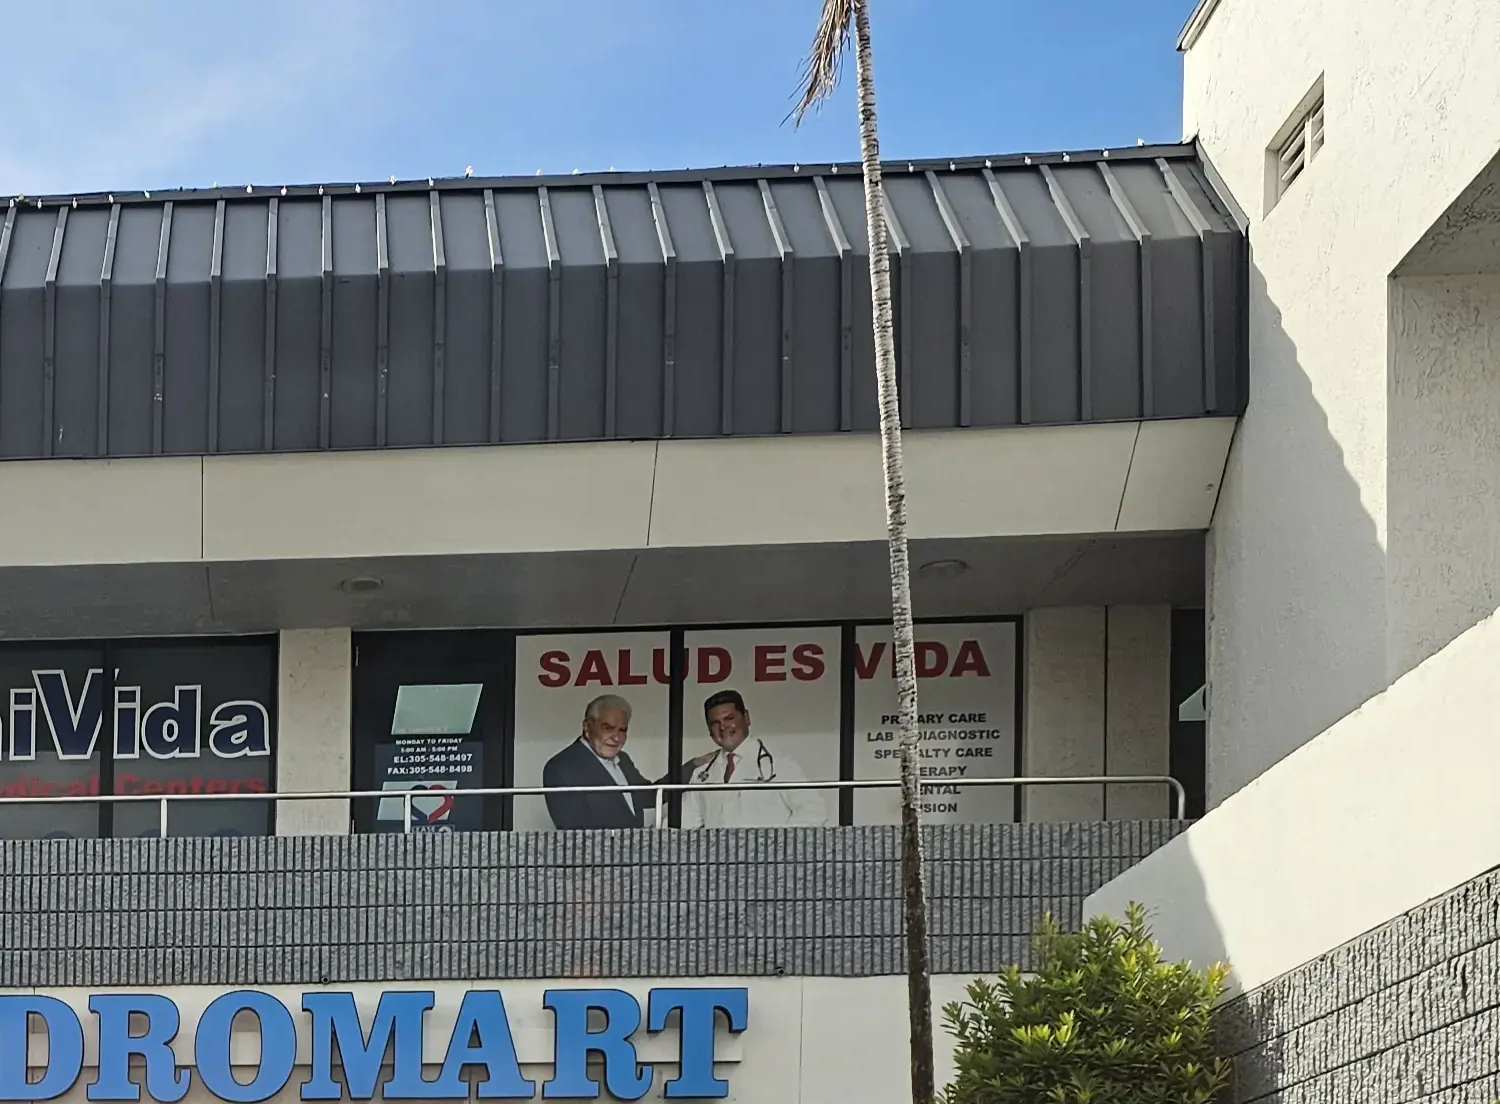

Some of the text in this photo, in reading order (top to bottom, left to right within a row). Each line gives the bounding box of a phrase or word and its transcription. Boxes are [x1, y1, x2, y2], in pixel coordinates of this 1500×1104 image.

[537, 640, 991, 688] SALUD ES VDA
[881, 713, 987, 725] PRARY CARE
[867, 732, 894, 742] LAB
[874, 747, 993, 760] SPEALTY CARE
[919, 766, 968, 776] ERAPY
[116, 773, 269, 796] Centers
[919, 803, 958, 813] ISION
